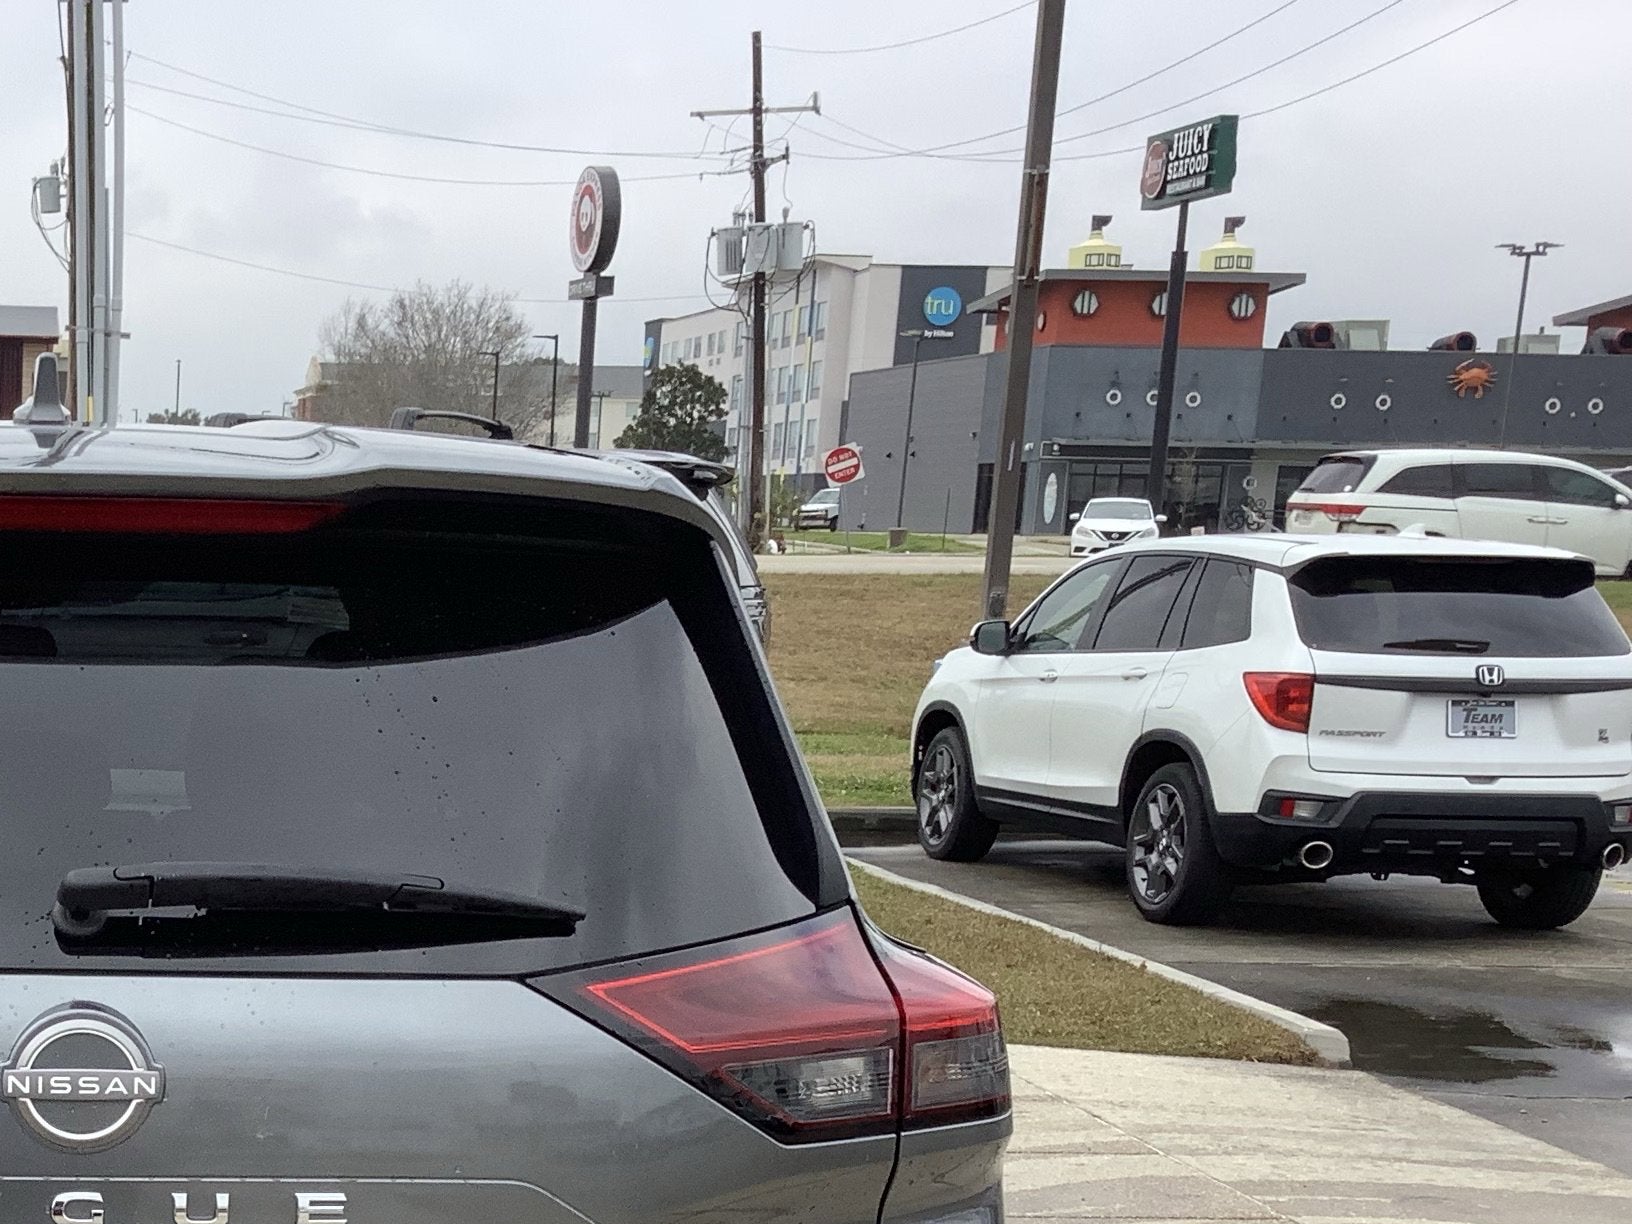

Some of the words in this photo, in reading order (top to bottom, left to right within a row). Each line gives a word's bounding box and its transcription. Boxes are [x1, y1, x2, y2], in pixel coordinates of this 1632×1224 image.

[1169, 123, 1213, 161] JUICY
[1166, 153, 1209, 180] SEAFOOD
[925, 296, 954, 315] tru
[1463, 708, 1504, 723] TEAM
[6, 1074, 157, 1096] NISSAN
